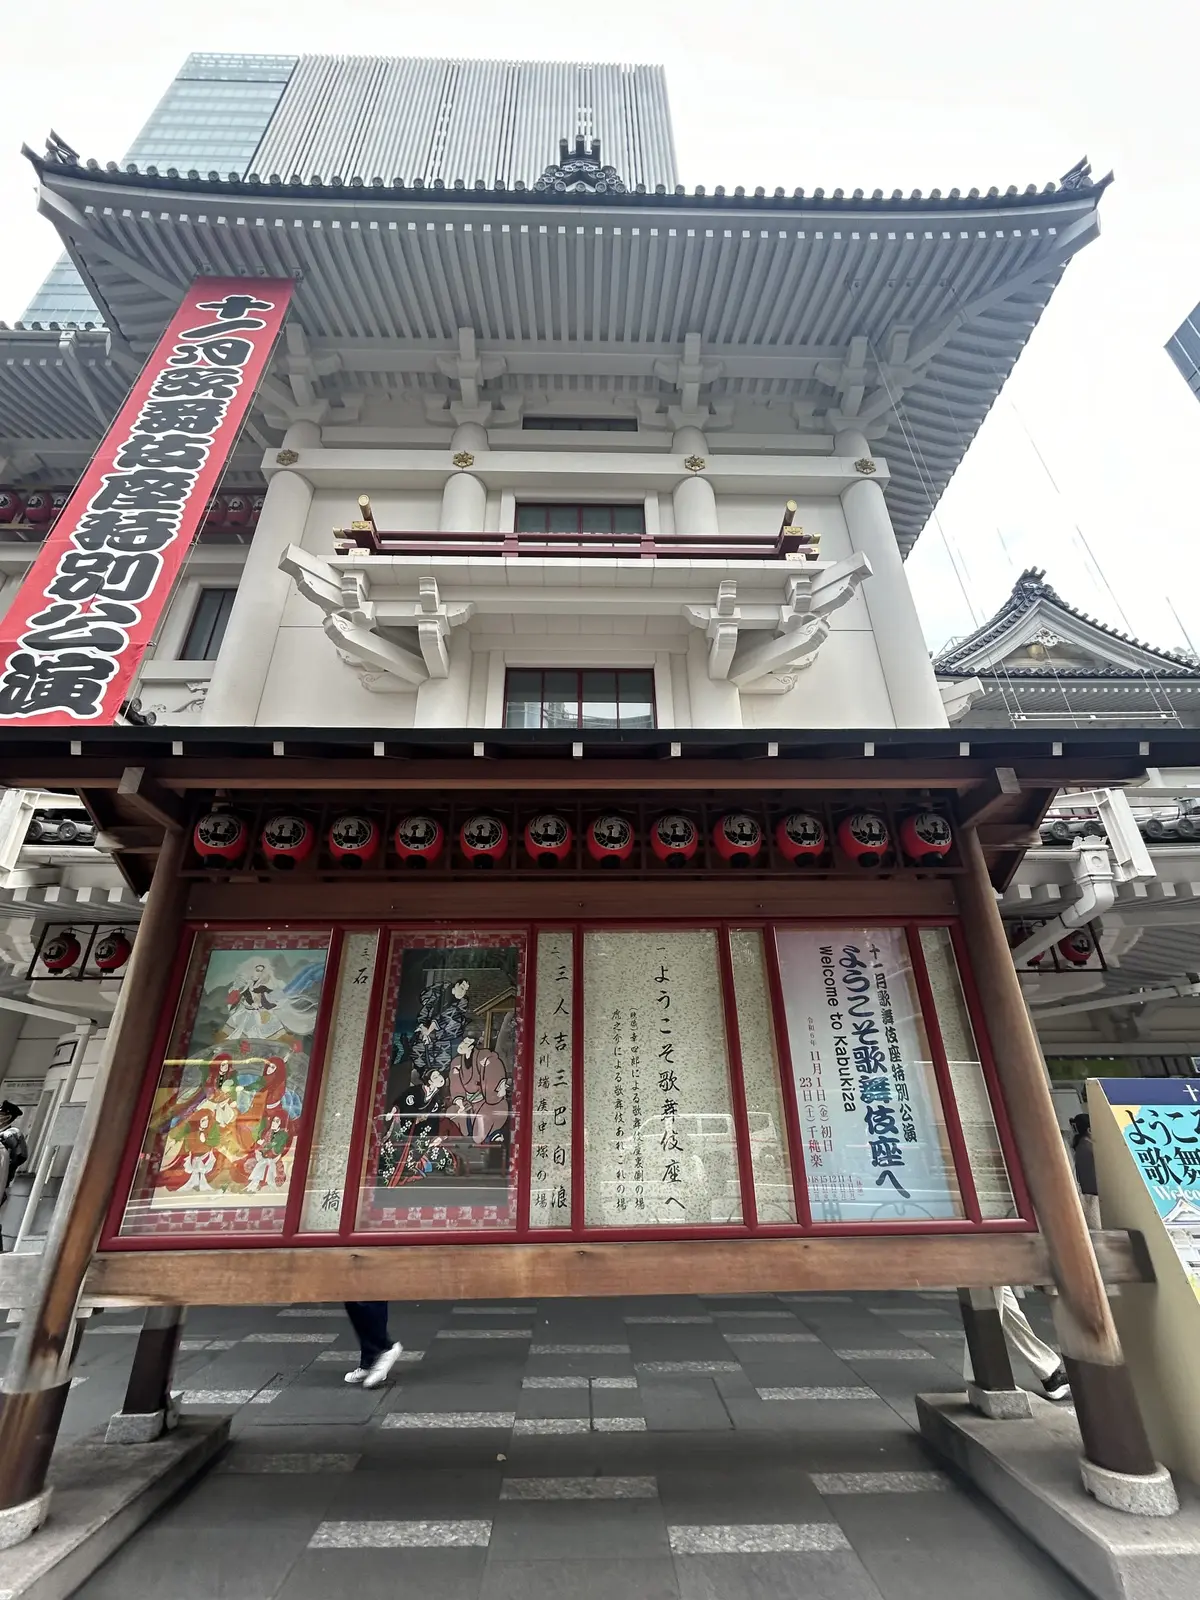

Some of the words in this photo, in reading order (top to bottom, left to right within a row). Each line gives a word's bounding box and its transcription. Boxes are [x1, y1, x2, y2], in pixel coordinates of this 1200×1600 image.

[0, 294, 275, 719] 十一月歌舞伎座特別公演
[819, 945, 839, 1007] Welcome
[829, 1011, 843, 1030] to
[839, 945, 911, 1199] ようこそ歌舞伎座へ
[869, 943, 918, 1142] 十一月歌舞伎座特別公演
